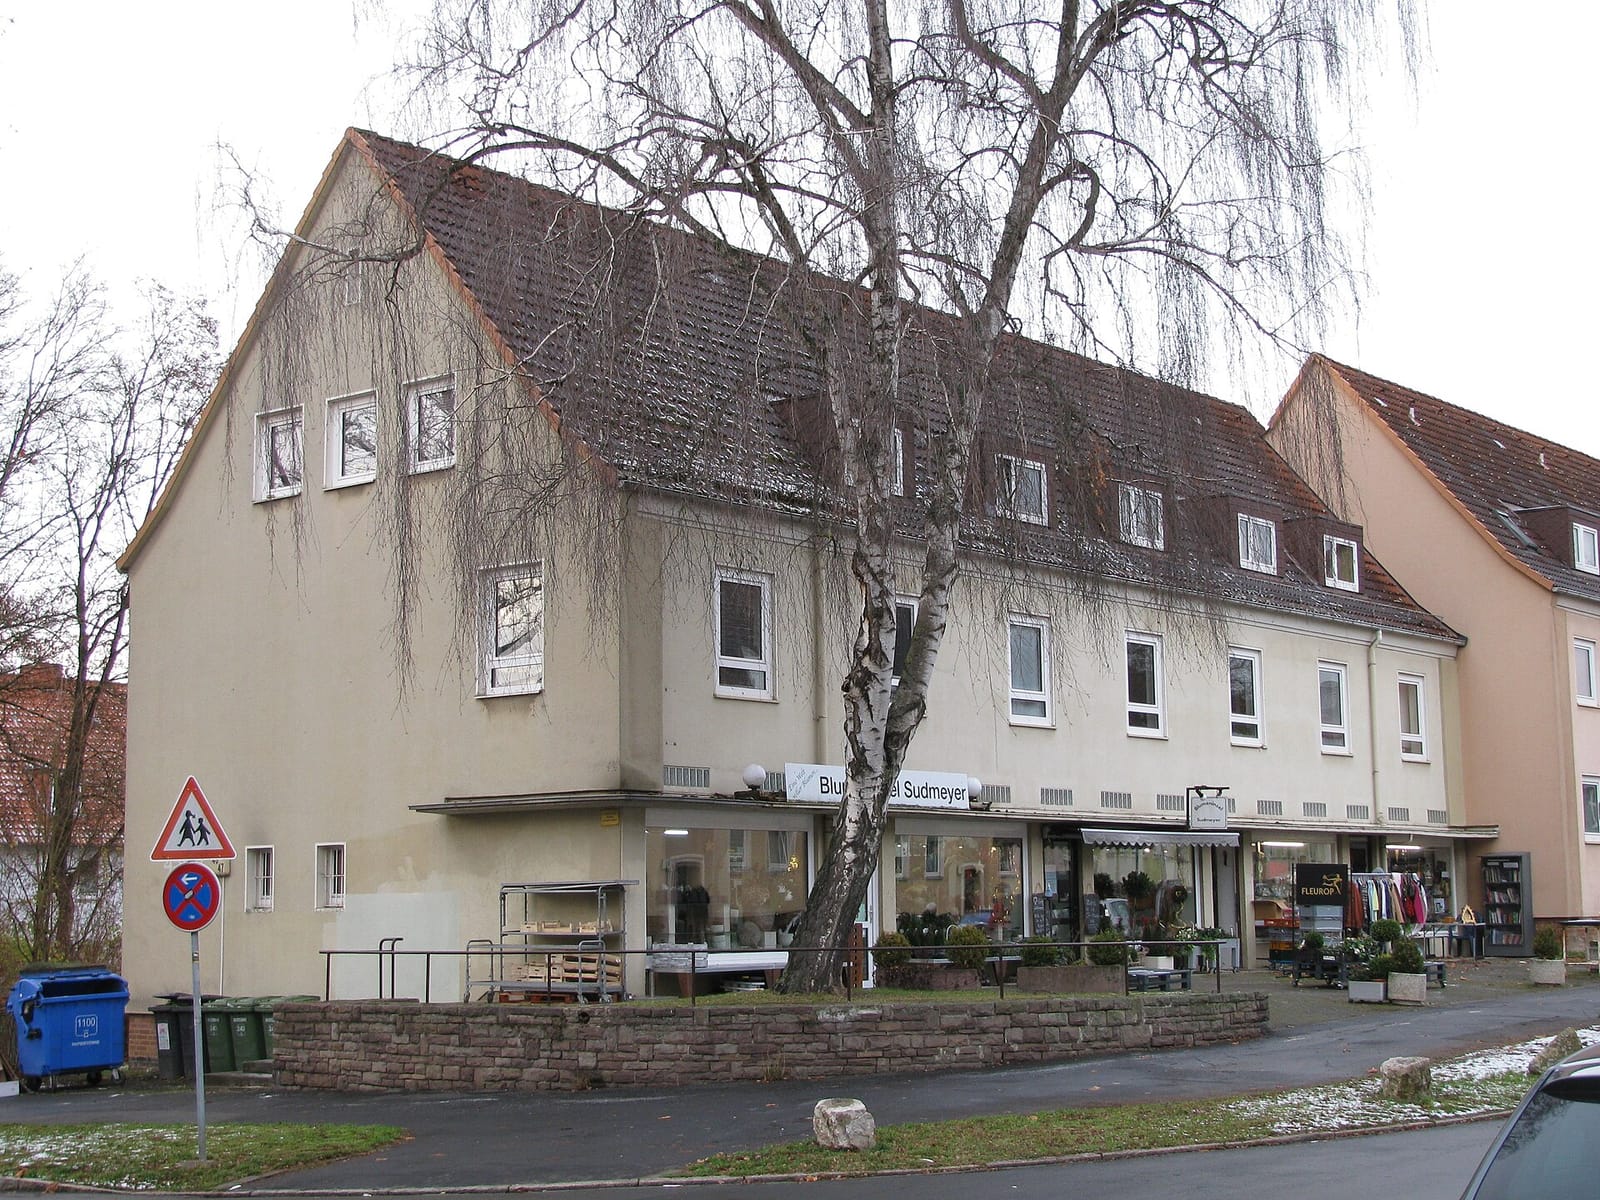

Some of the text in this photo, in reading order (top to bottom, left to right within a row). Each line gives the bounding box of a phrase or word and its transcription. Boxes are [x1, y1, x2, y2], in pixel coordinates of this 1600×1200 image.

[904, 780, 966, 804] Sudmeyer
[1301, 887, 1335, 896] FLEUROP
[78, 1017, 96, 1027] 1100
